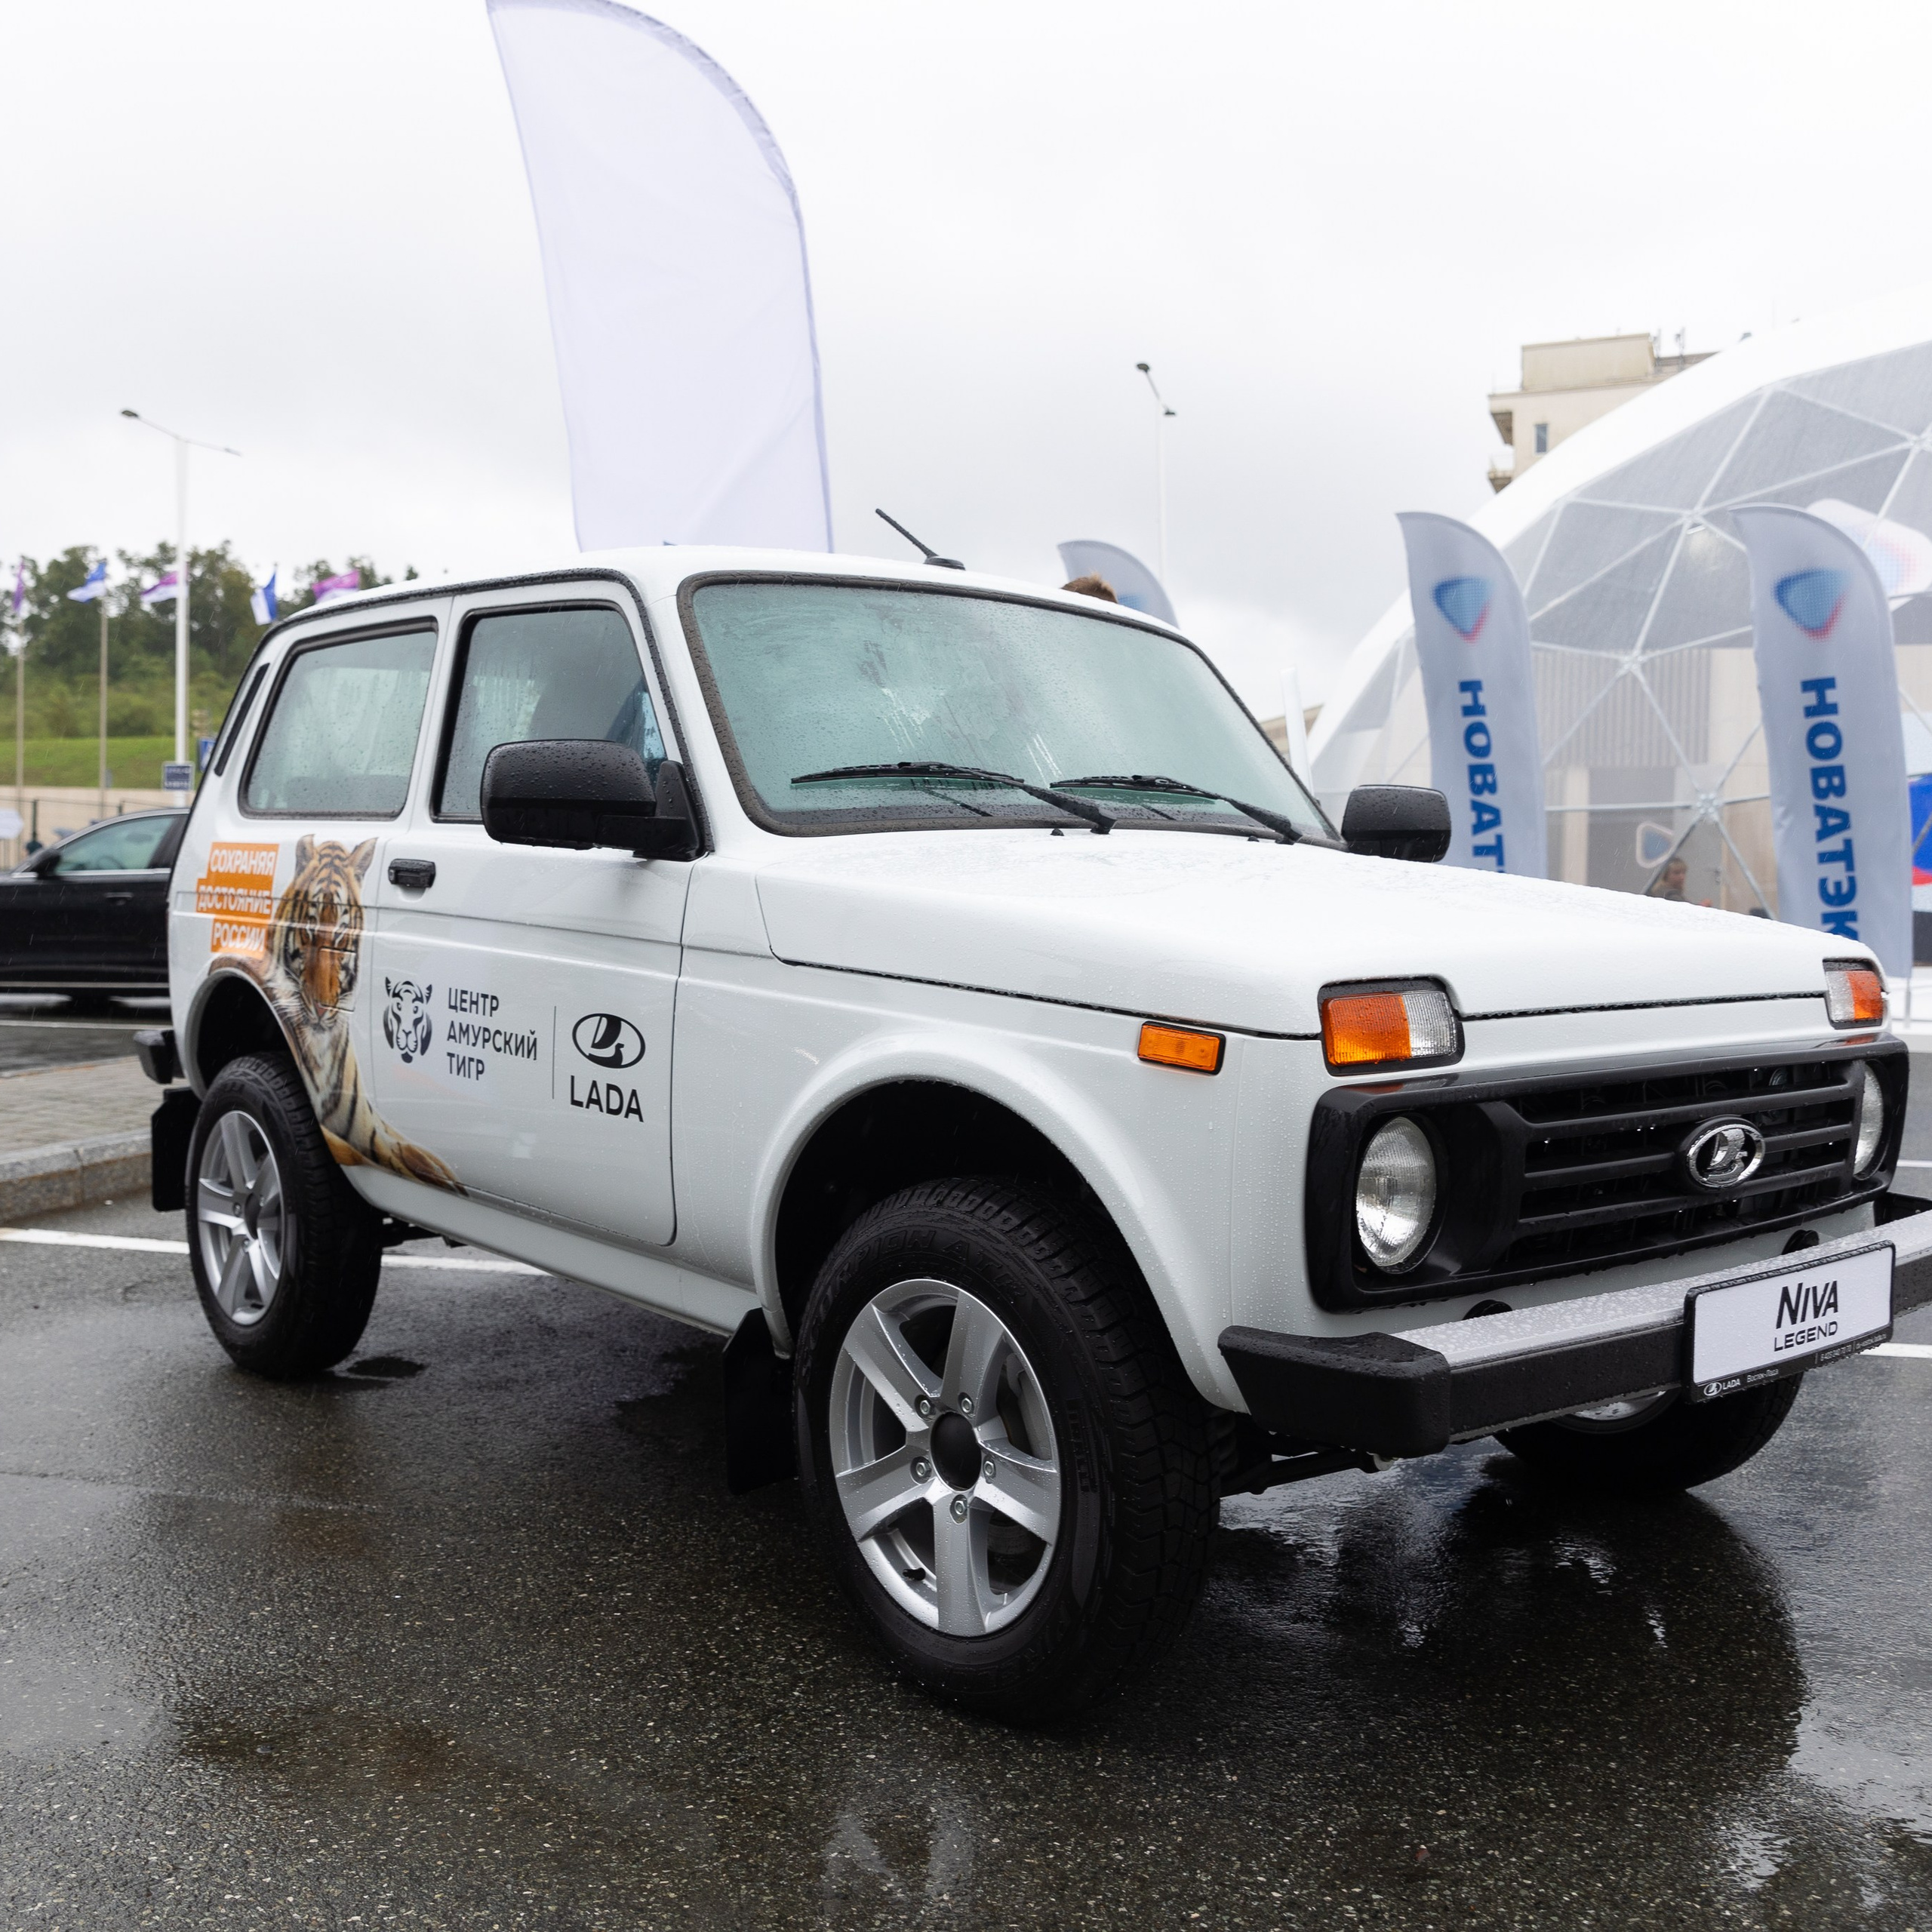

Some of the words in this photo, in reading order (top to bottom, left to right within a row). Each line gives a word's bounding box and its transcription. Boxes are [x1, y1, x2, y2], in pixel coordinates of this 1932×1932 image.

[1458, 680, 1506, 873] НОВАТ
[210, 848, 277, 876] СОХРАНЯЯ
[198, 884, 271, 915] ДОСТОЯНИЕ
[213, 921, 266, 952] РОССИИ
[448, 987, 500, 1017] ЦЕНТР
[447, 1020, 537, 1060] АМУРСКИЙ
[447, 1052, 485, 1081] ТИГР
[571, 1075, 644, 1123] LADA
[1776, 1280, 1838, 1329] NIVA
[1774, 1321, 1838, 1352] LEGEND
[1722, 1379, 1741, 1390] LADA
